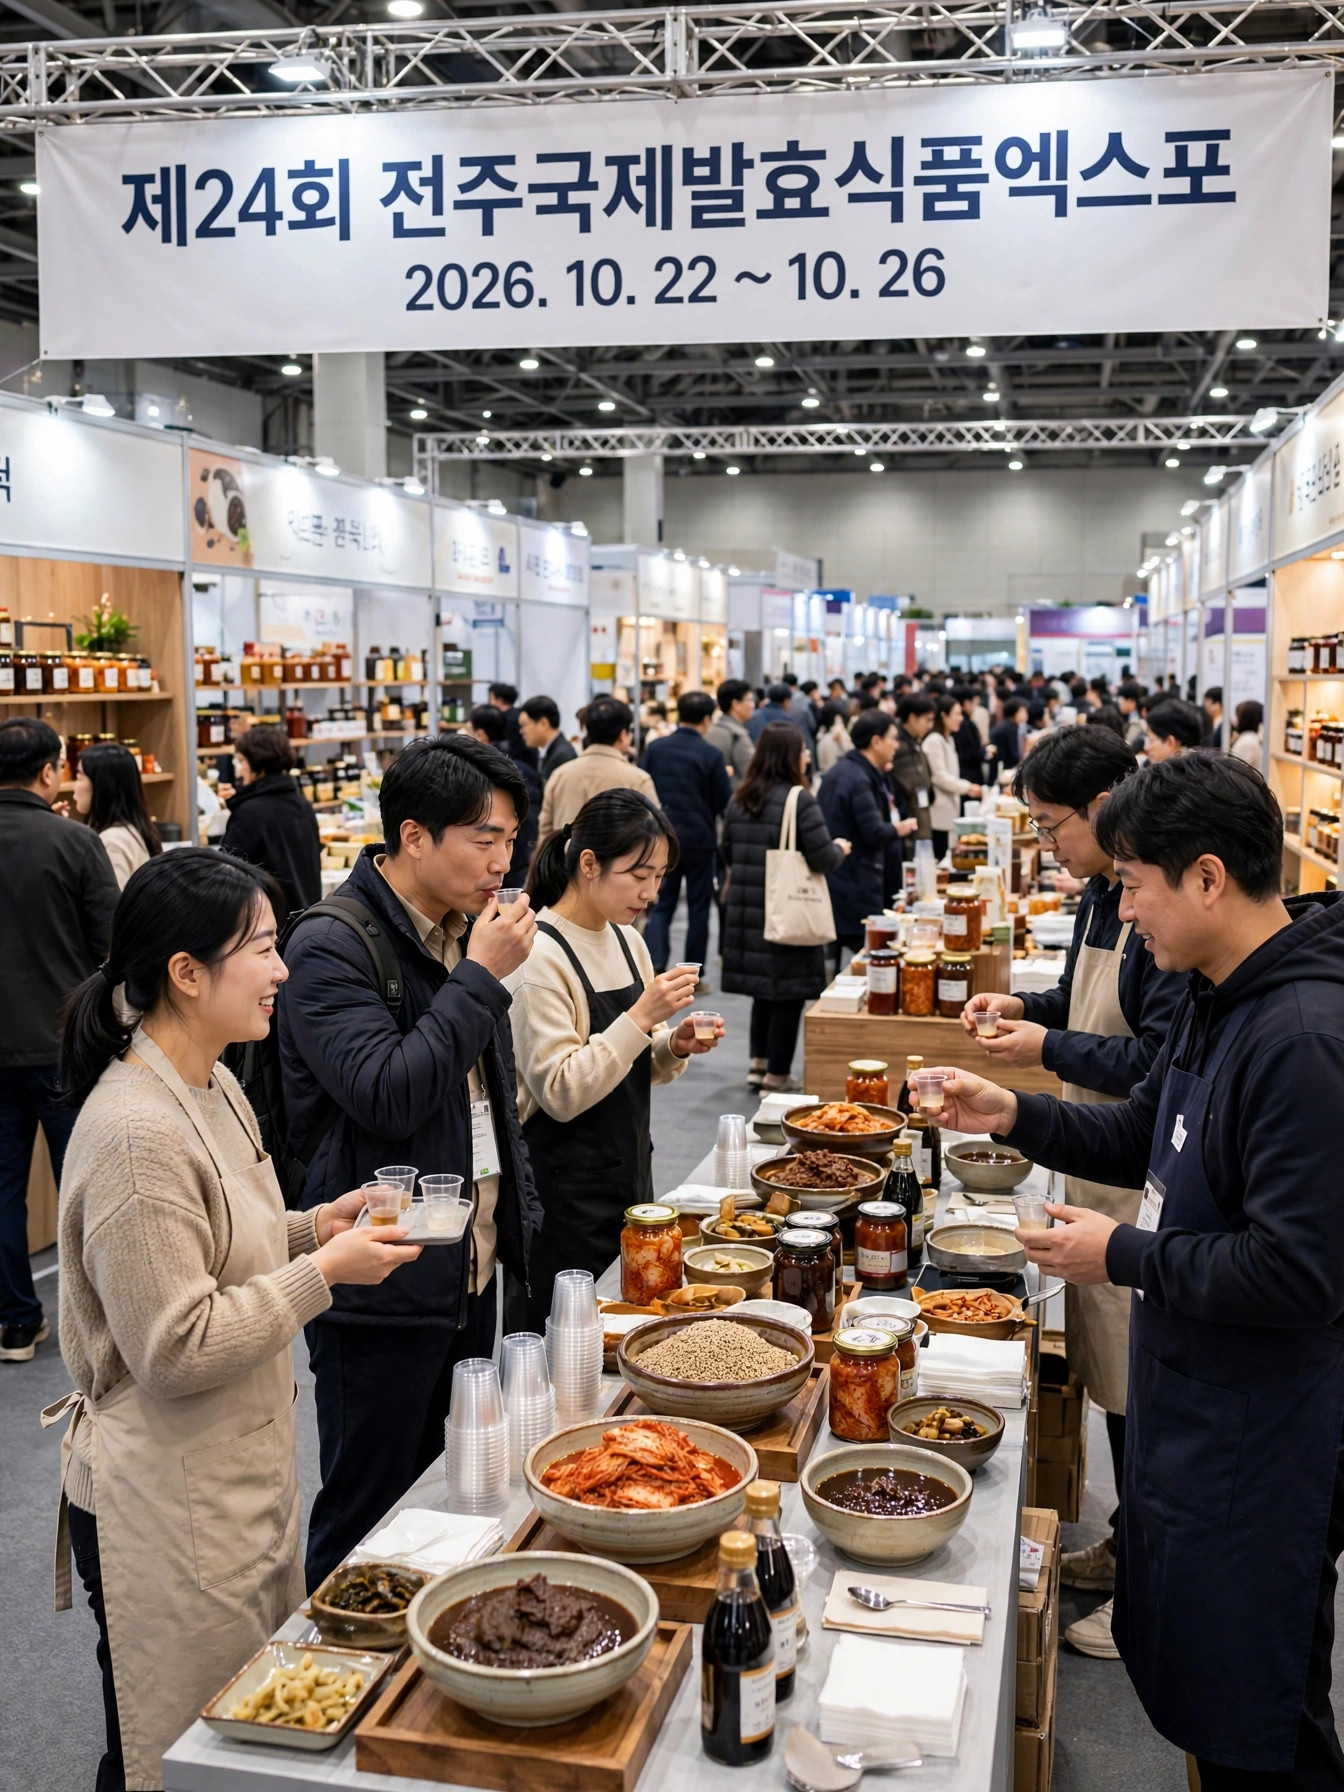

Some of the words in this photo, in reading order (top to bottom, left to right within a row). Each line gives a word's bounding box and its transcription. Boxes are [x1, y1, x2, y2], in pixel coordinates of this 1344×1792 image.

[121, 159, 351, 247] 제24회
[379, 128, 1238, 239] 전주국제발효식품엑스포
[405, 261, 548, 312] 2026.
[566, 258, 636, 307] 10.
[654, 255, 718, 305] 22
[788, 250, 860, 301] 10.
[878, 247, 946, 298] 26
